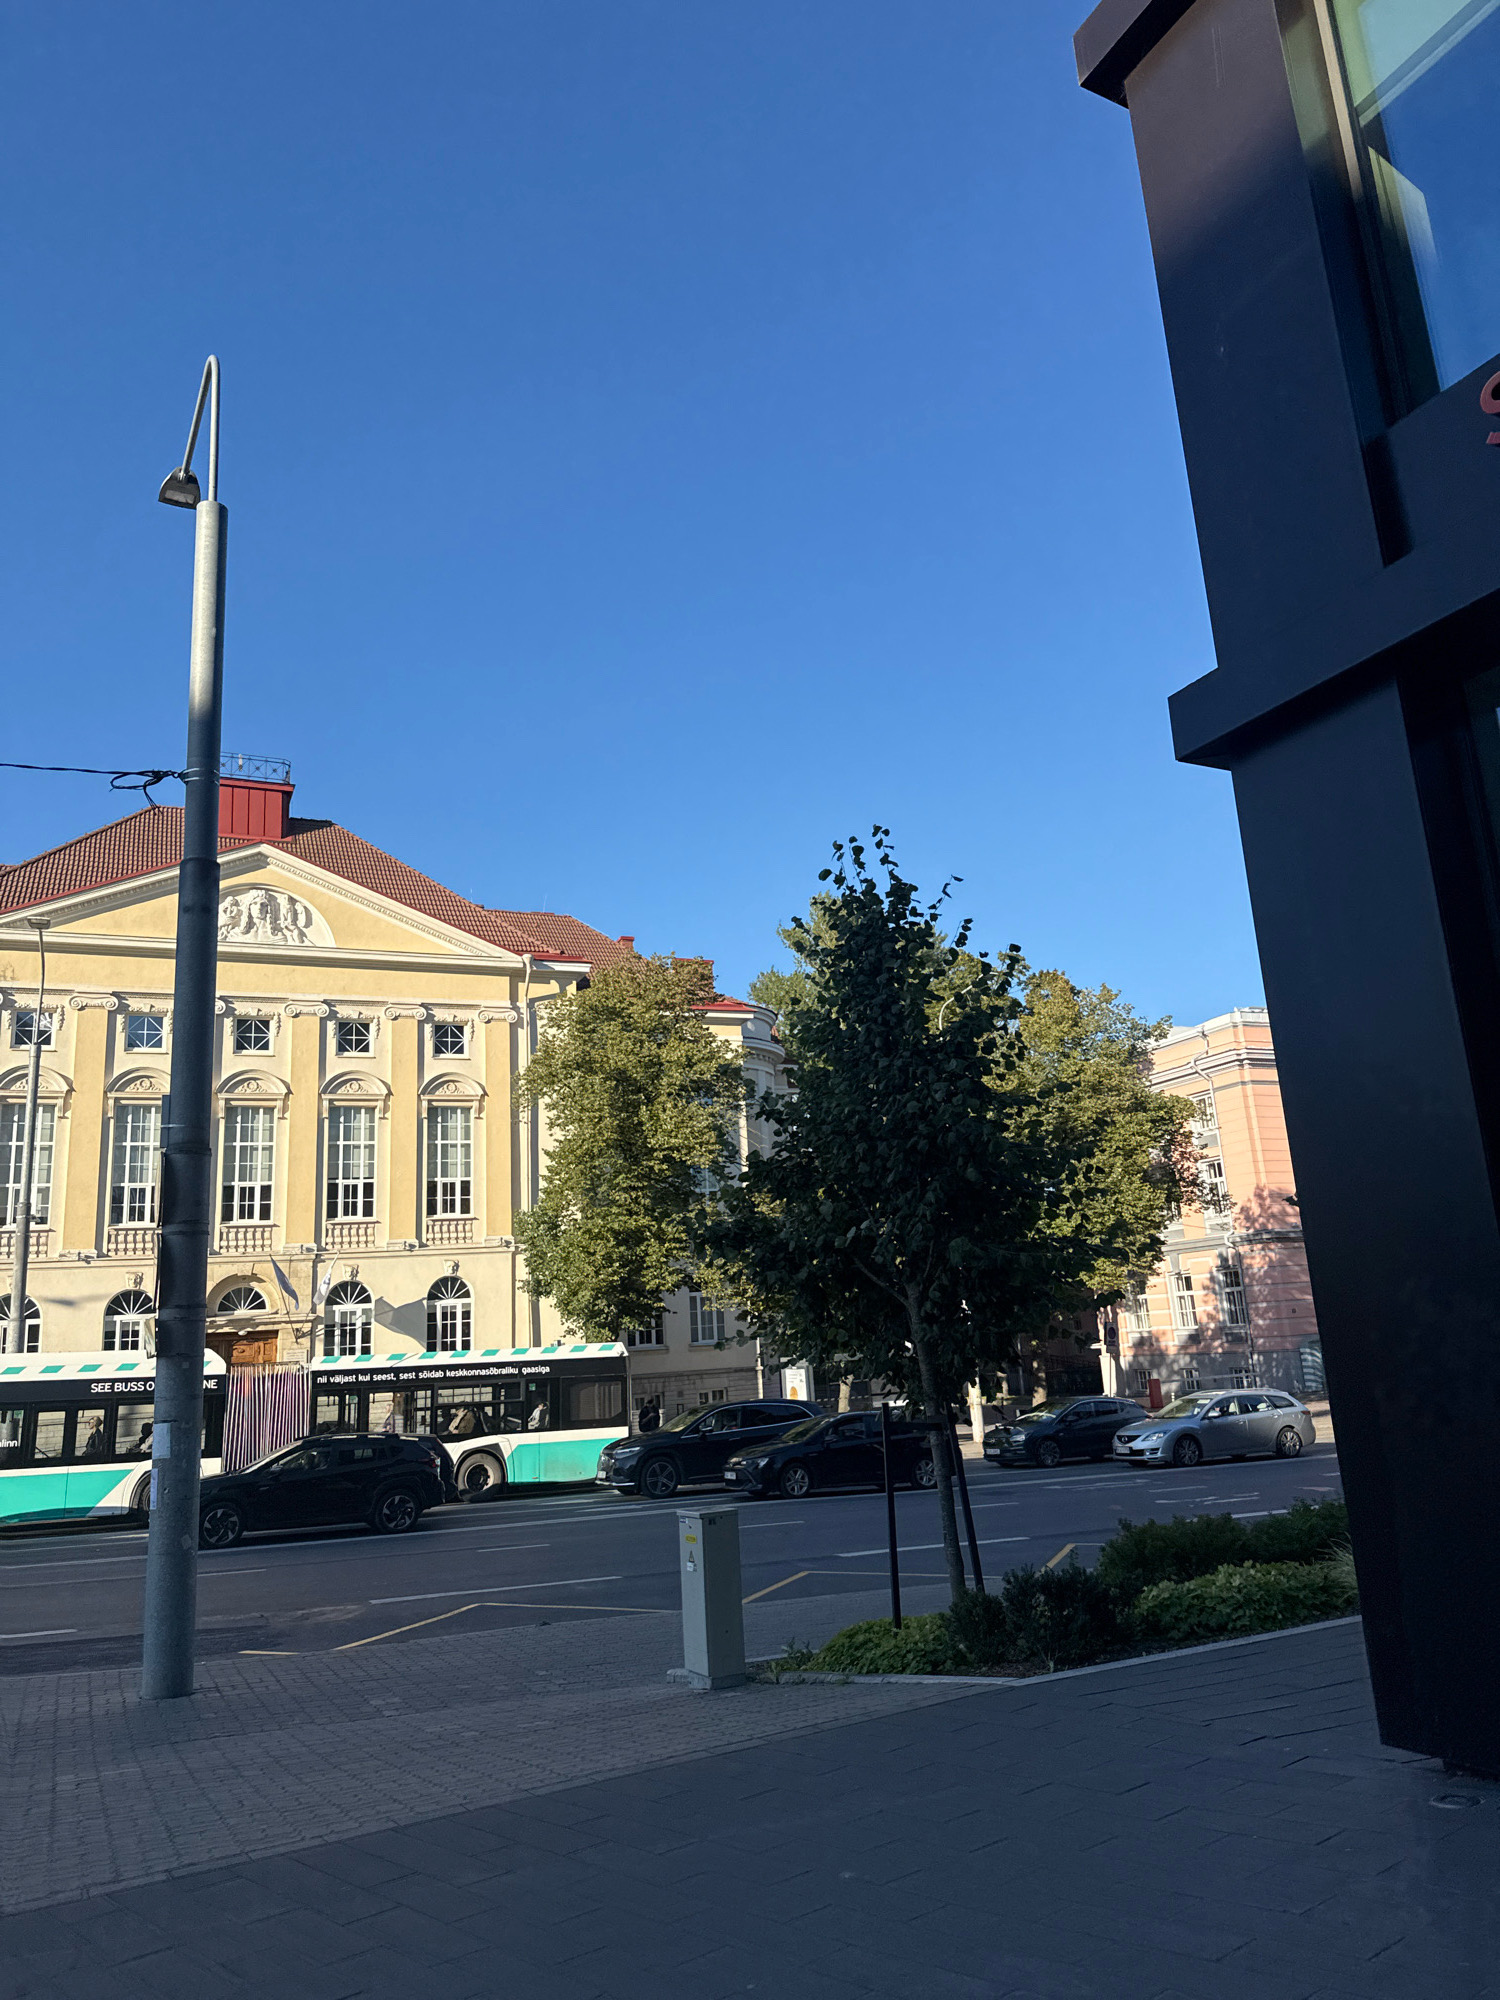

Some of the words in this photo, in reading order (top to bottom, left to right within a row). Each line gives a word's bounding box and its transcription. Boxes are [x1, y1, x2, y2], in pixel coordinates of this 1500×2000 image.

[317, 1375, 327, 1384] nii
[329, 1374, 356, 1384] väljast
[358, 1373, 371, 1382] kui
[372, 1372, 397, 1382] seest,
[399, 1371, 416, 1380] sest
[418, 1370, 444, 1379] sõidab
[446, 1366, 518, 1378] keskkonnasõbraliku
[521, 1365, 550, 1375] gaasiga
[91, 1382, 112, 1393] SEE
[114, 1381, 144, 1392] BUSS
[146, 1381, 155, 1391] O
